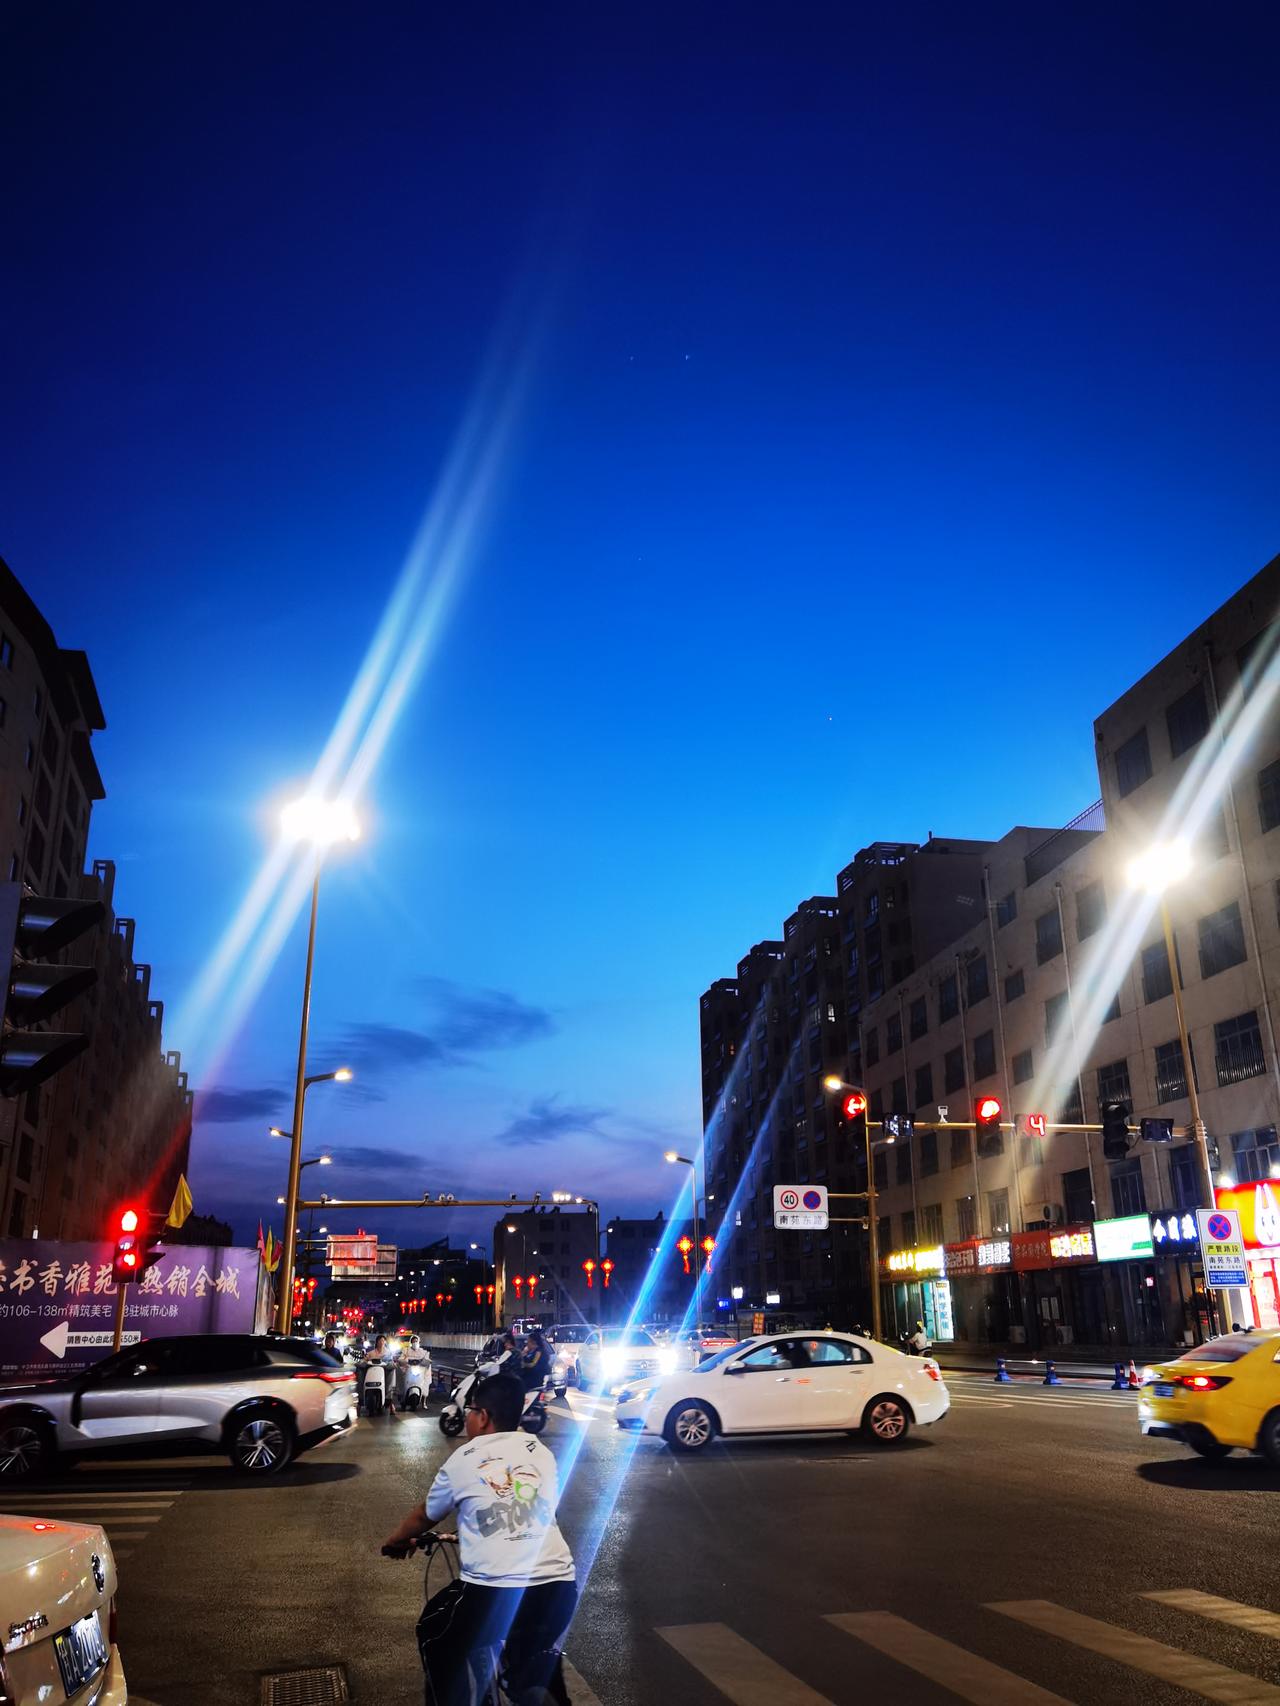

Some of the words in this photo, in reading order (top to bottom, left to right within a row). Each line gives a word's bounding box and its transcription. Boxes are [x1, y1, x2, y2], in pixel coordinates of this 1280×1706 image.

[784, 1194, 795, 1206] 40
[779, 1214, 824, 1226] 南苑东路
[1208, 1256, 1241, 1265] 南苑东路
[0, 1259, 117, 1297] 书香雅苑
[137, 1264, 241, 1300] 热销全城
